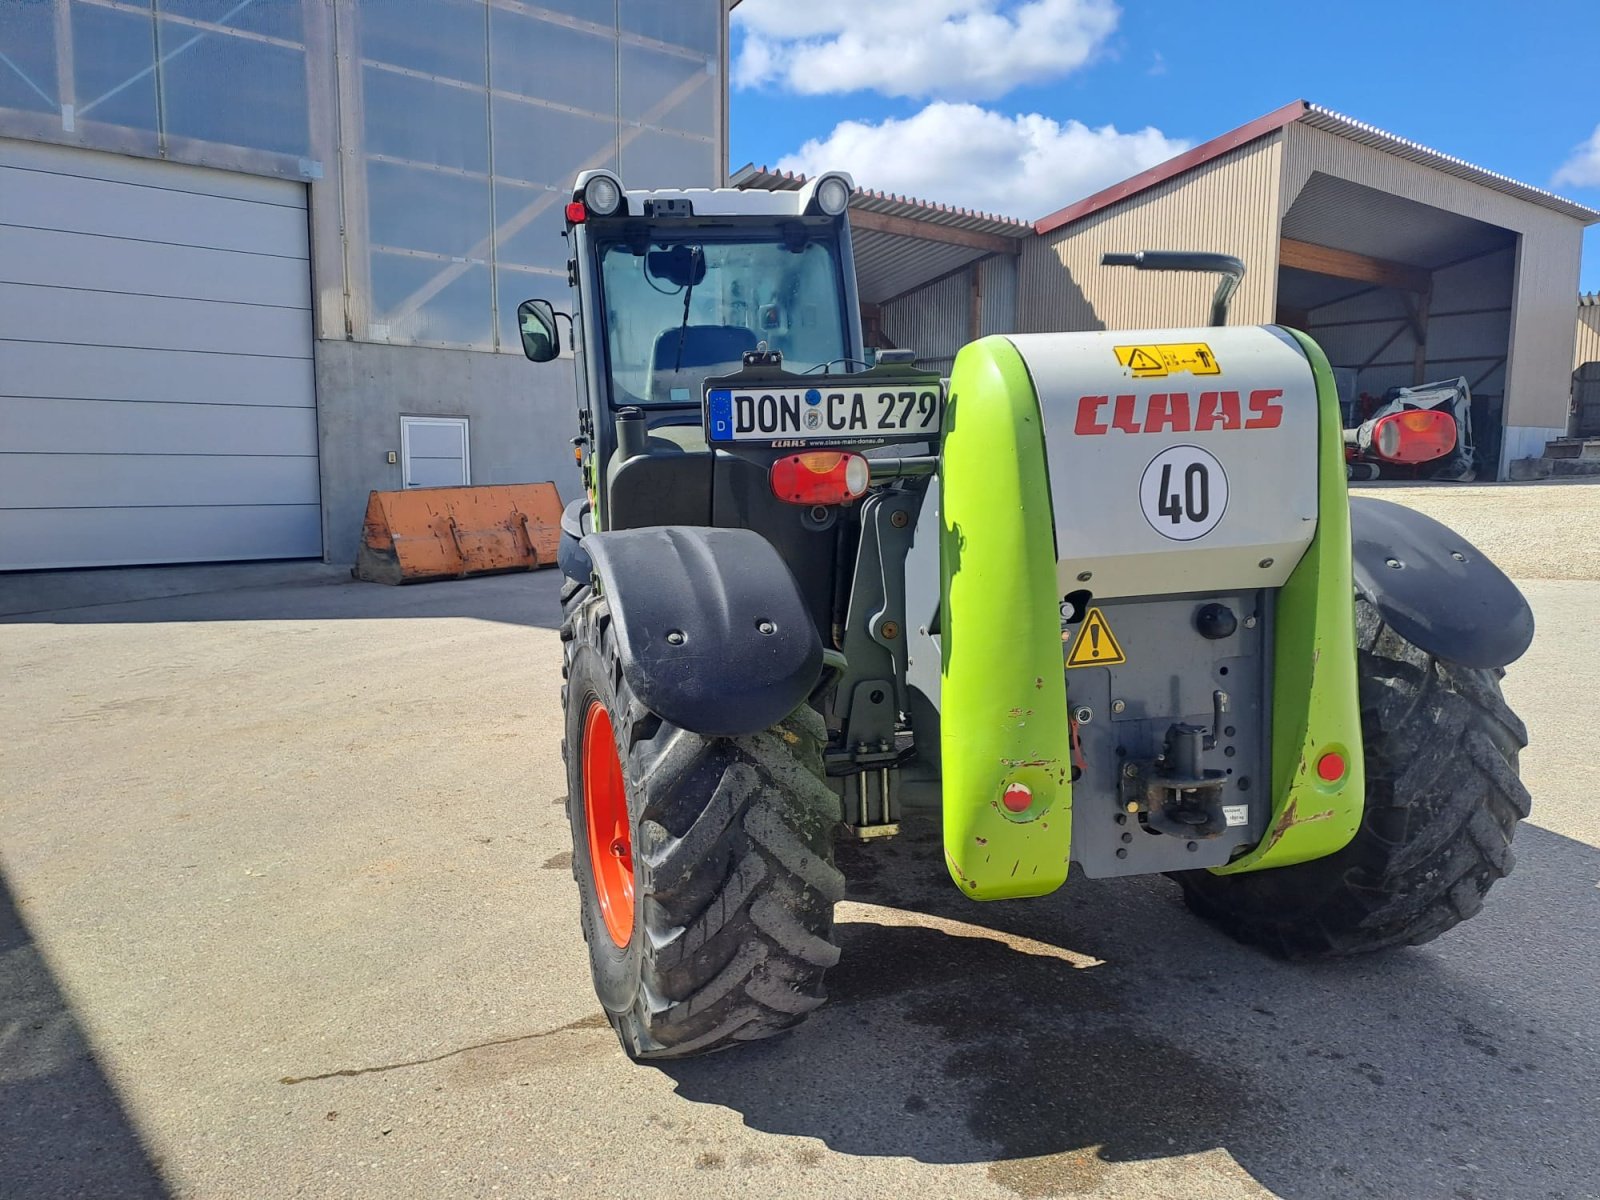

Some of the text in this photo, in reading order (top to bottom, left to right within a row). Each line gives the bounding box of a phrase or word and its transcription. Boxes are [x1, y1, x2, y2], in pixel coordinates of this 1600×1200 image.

[717, 420, 726, 432] D
[735, 391, 937, 433] DON CA 279
[1074, 389, 1284, 436] CLAAS
[771, 440, 806, 448] CLAAS
[1158, 462, 1210, 524] 40
